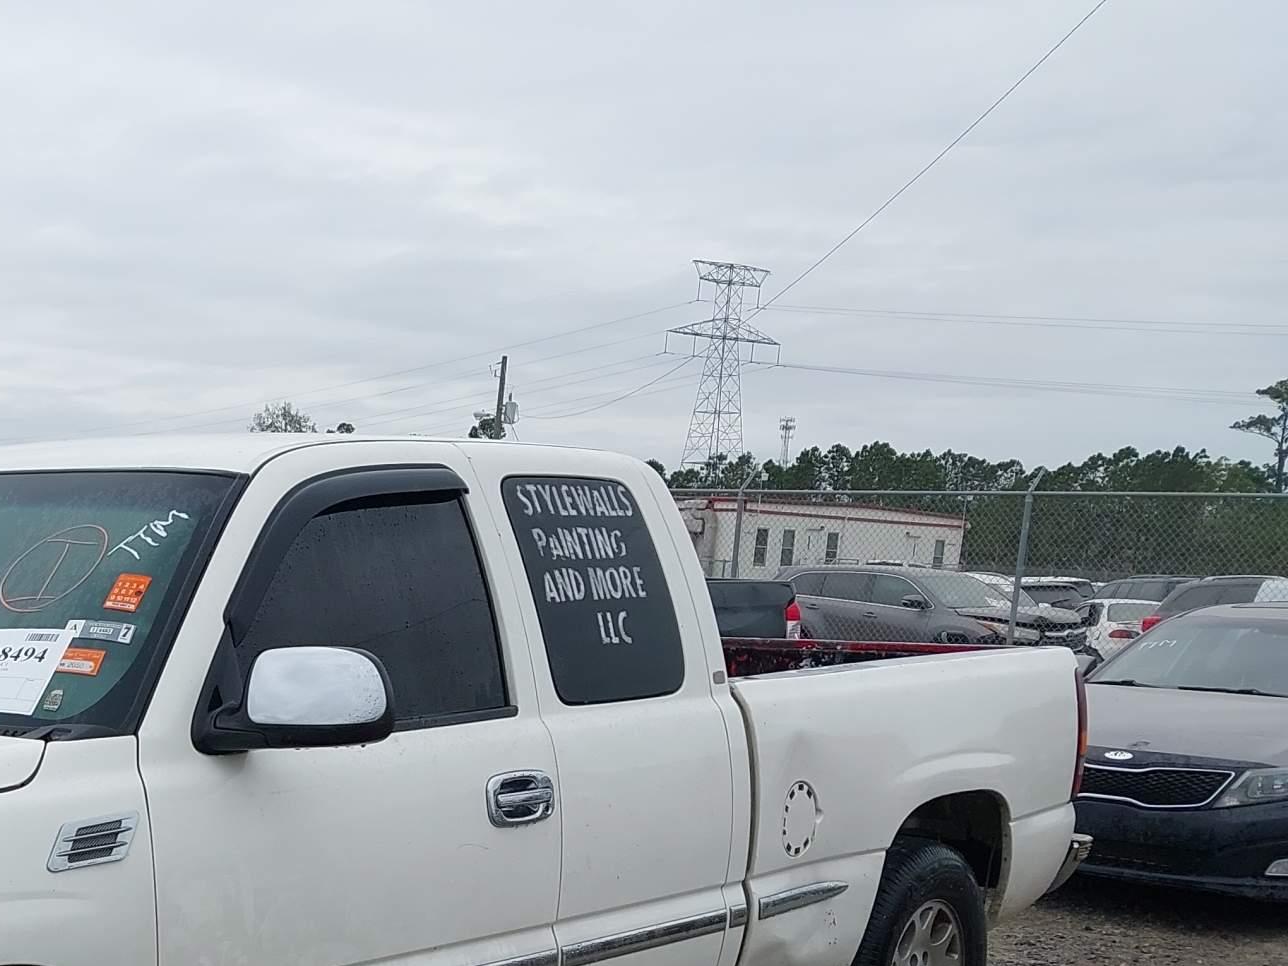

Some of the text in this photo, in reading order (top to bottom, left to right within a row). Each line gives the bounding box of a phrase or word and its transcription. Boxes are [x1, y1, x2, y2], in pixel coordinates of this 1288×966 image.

[516, 484, 633, 516] STYLEWALLS
[531, 527, 627, 561] PAINTING
[543, 566, 647, 603] AND MORE
[122, 626, 131, 637] 7
[596, 610, 634, 645] LLC
